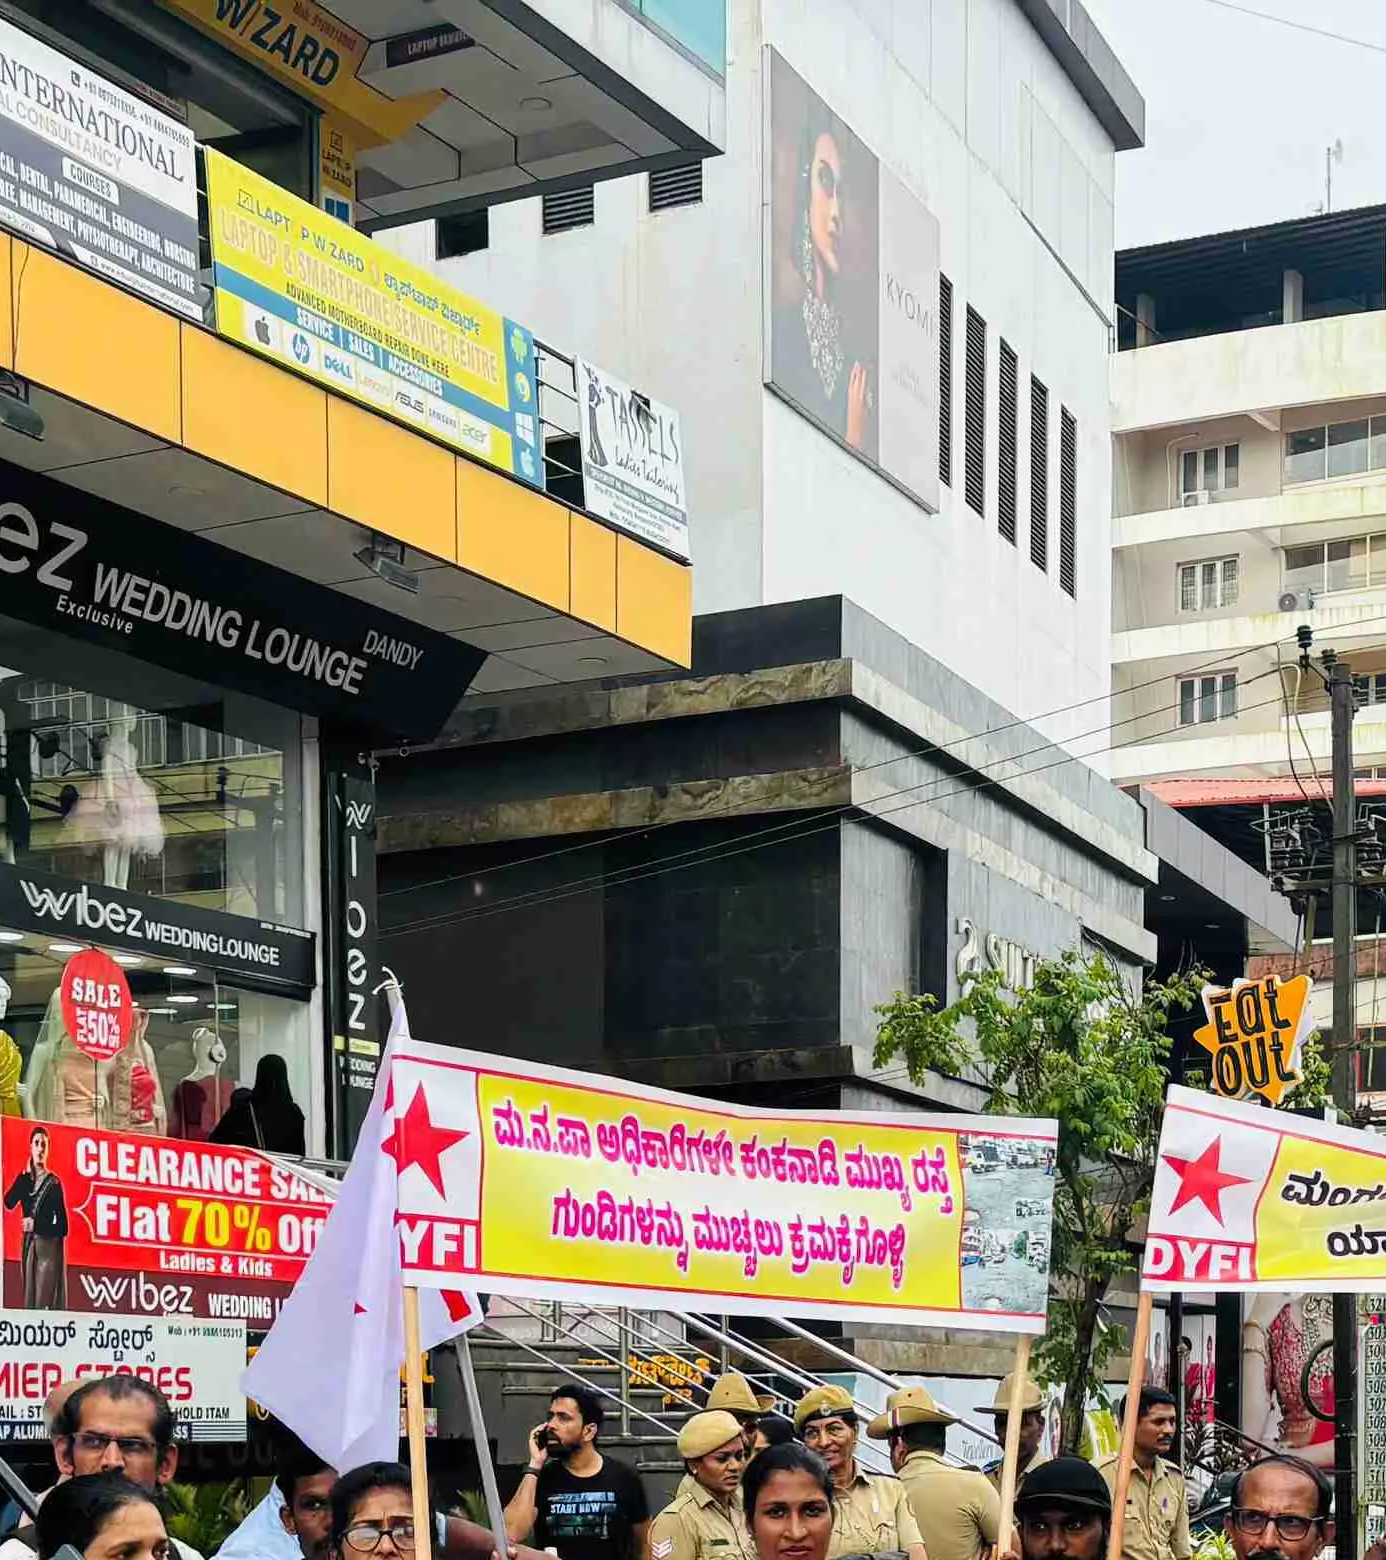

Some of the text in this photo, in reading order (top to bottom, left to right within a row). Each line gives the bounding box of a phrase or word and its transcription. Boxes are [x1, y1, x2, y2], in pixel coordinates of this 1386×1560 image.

[16, 102, 122, 174] CONSULTANCY
[70, 163, 111, 196] COURSES
[220, 208, 277, 267] LAPTOP
[298, 254, 391, 324] SMARTPHONE
[393, 300, 448, 361] SERVICE
[286, 283, 326, 315] ADVANCED
[296, 308, 335, 343] SERVICE
[56, 594, 134, 635] Exclusive
[94, 562, 368, 695] WEDDING LOUNGE
[362, 628, 424, 671] DANDY
[143, 920, 281, 967] WEDDING LOUNGE
[71, 977, 122, 1009] SALE
[75, 1136, 262, 1200] CLEARANCE
[739, 1136, 839, 1188] ಕಂಕನಾಡಿ
[845, 1149, 912, 1213] ಮುಖ್ಯ
[911, 1144, 955, 1214] ರಸ್ತೆ
[95, 1195, 272, 1251] Flat 70%
[550, 1187, 690, 1272] ಗುಂಡಿಗಳನ್ನು
[691, 1211, 784, 1279] ಮುಚ್ಚಲು
[160, 1250, 273, 1277] Ladies & Kids
[1144, 1236, 1253, 1282] DYFI
[208, 1293, 272, 1320] WEDDING
